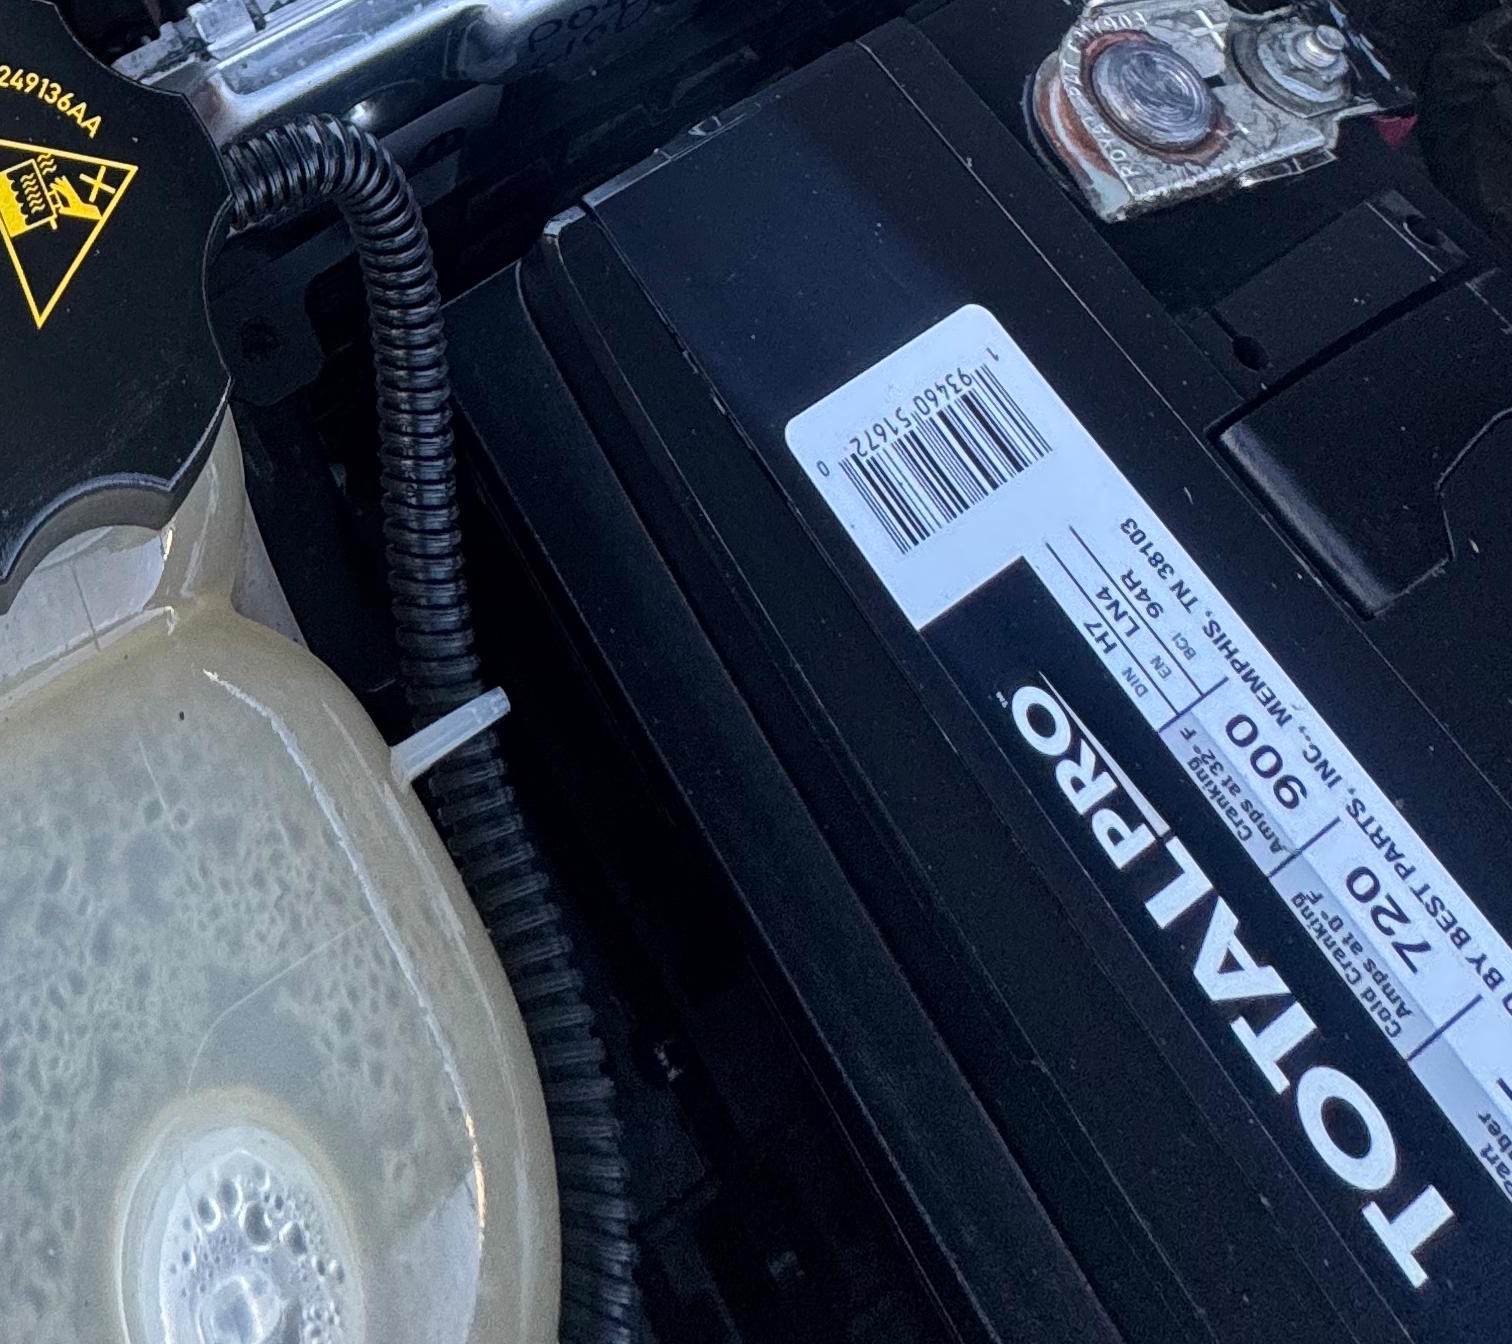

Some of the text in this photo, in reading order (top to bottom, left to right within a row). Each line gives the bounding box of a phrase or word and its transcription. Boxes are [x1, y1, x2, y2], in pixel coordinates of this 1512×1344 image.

[913, 368, 972, 415] 93460
[850, 407, 911, 457] 51672
[1121, 518, 1174, 579] 38103
[1122, 569, 1196, 660] BCI 94R
[1170, 580, 1198, 614] TN
[1084, 623, 1148, 697] DIN H7
[1096, 587, 1172, 679] EN LN4
[1203, 611, 1292, 727] MEMPHIS,
[1221, 775, 1241, 797] at
[1226, 715, 1307, 809] 900
[1187, 757, 1252, 841] Cranking
[1241, 799, 1287, 853] Amps
[1346, 788, 1416, 880] PARTS,
[1342, 933, 1363, 955] at
[1346, 867, 1431, 974] 720
[1410, 884, 1471, 950] BEST
[1291, 892, 1401, 1037] Cold Cranking
[1363, 958, 1412, 1018] Amps
[1466, 954, 1504, 991] BY
